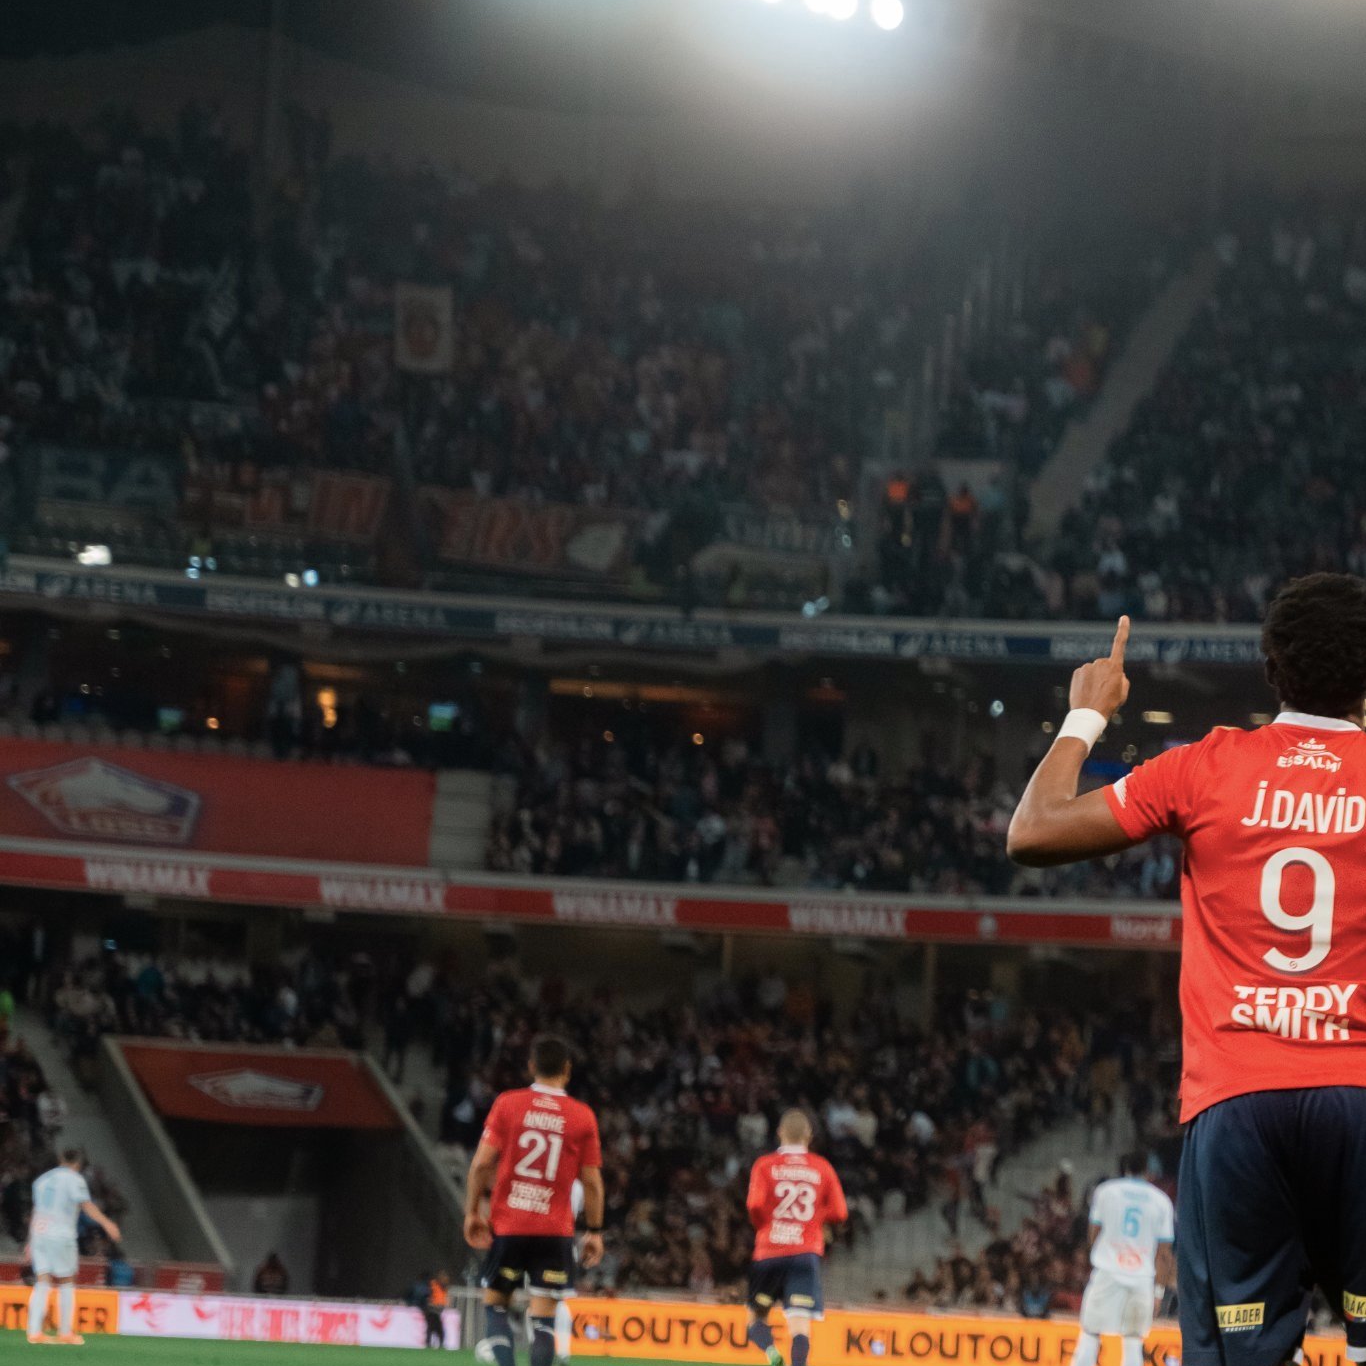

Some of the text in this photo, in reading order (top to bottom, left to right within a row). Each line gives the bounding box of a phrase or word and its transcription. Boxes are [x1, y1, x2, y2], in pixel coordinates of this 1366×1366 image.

[320, 875, 447, 914] WINAMAX
[553, 889, 679, 926] WINAMAX
[1260, 847, 1335, 973] 9
[788, 901, 907, 934] WINAMAX
[1232, 984, 1359, 1015] TEDDY
[1230, 1003, 1351, 1041] SMITH
[514, 1129, 563, 1182] 21
[772, 1181, 817, 1223] 23
[1122, 1205, 1142, 1239] 6
